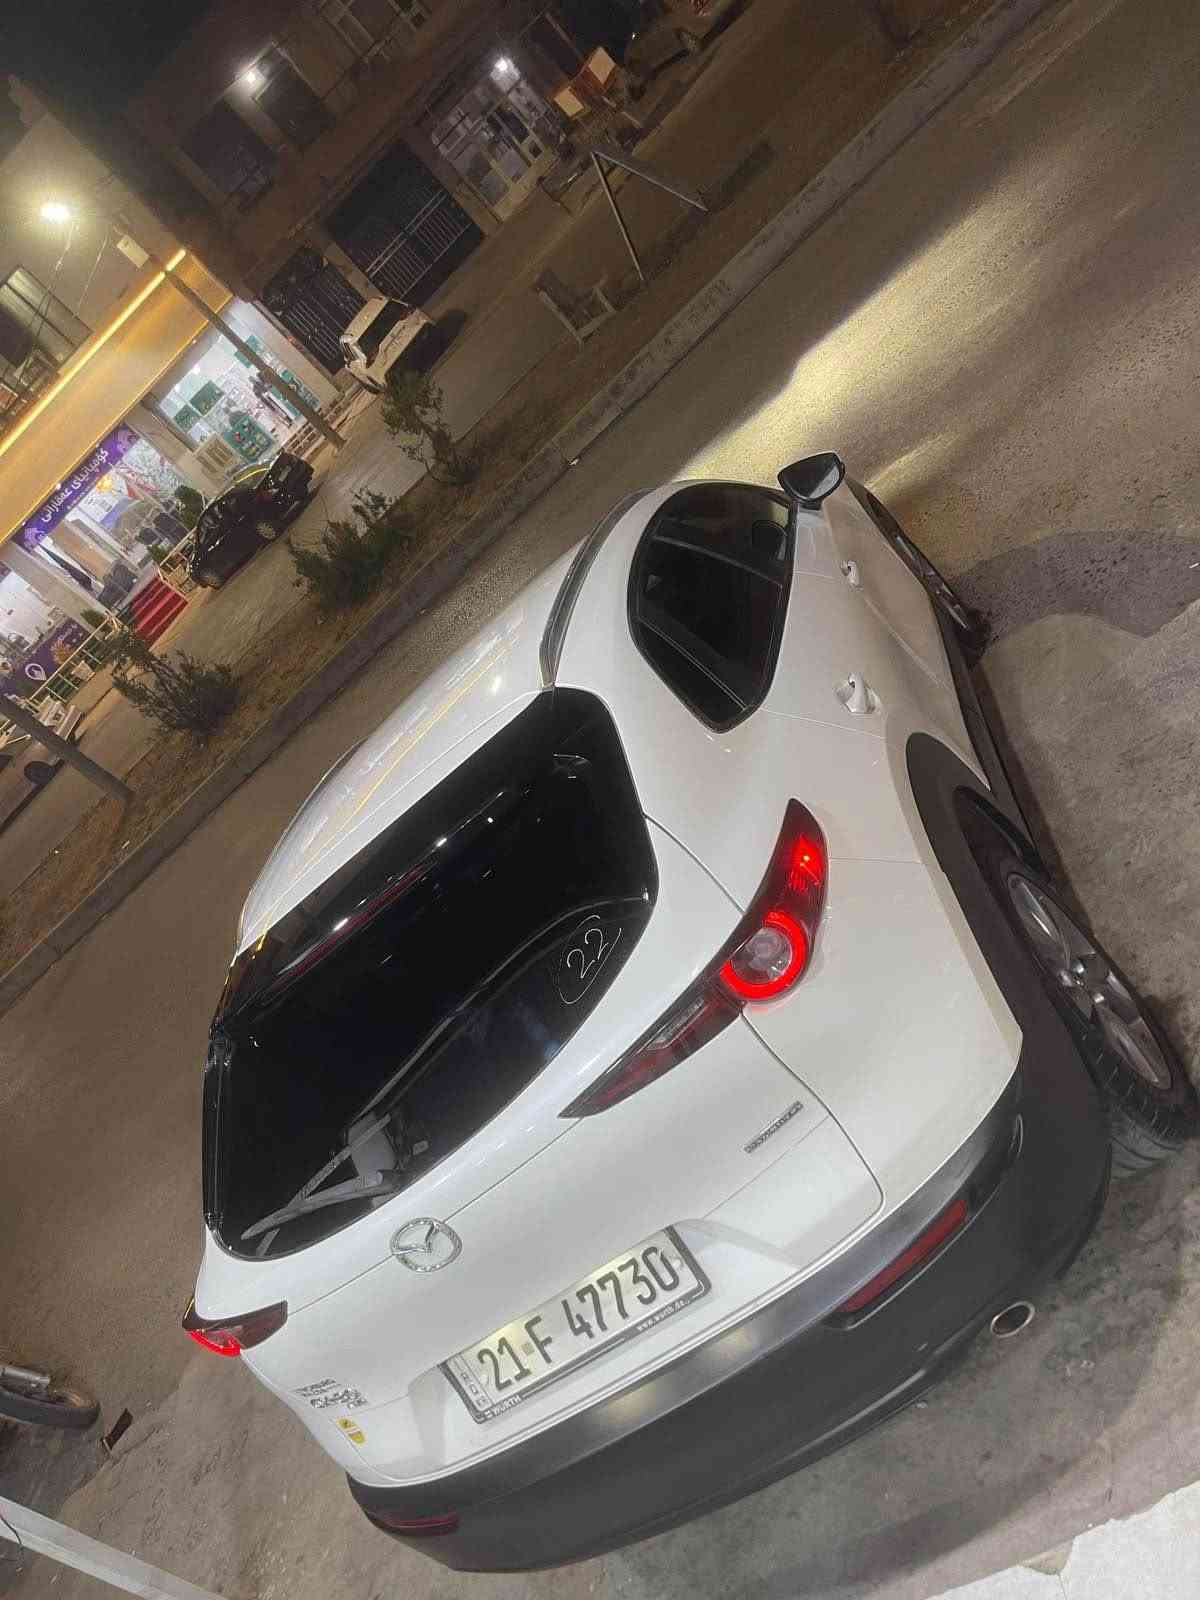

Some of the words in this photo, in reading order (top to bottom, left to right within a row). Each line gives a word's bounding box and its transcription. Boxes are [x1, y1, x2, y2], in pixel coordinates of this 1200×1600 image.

[566, 928, 609, 979] 22
[477, 1336, 532, 1391] 21
[524, 1315, 553, 1364] F
[561, 1246, 679, 1339] 47730
